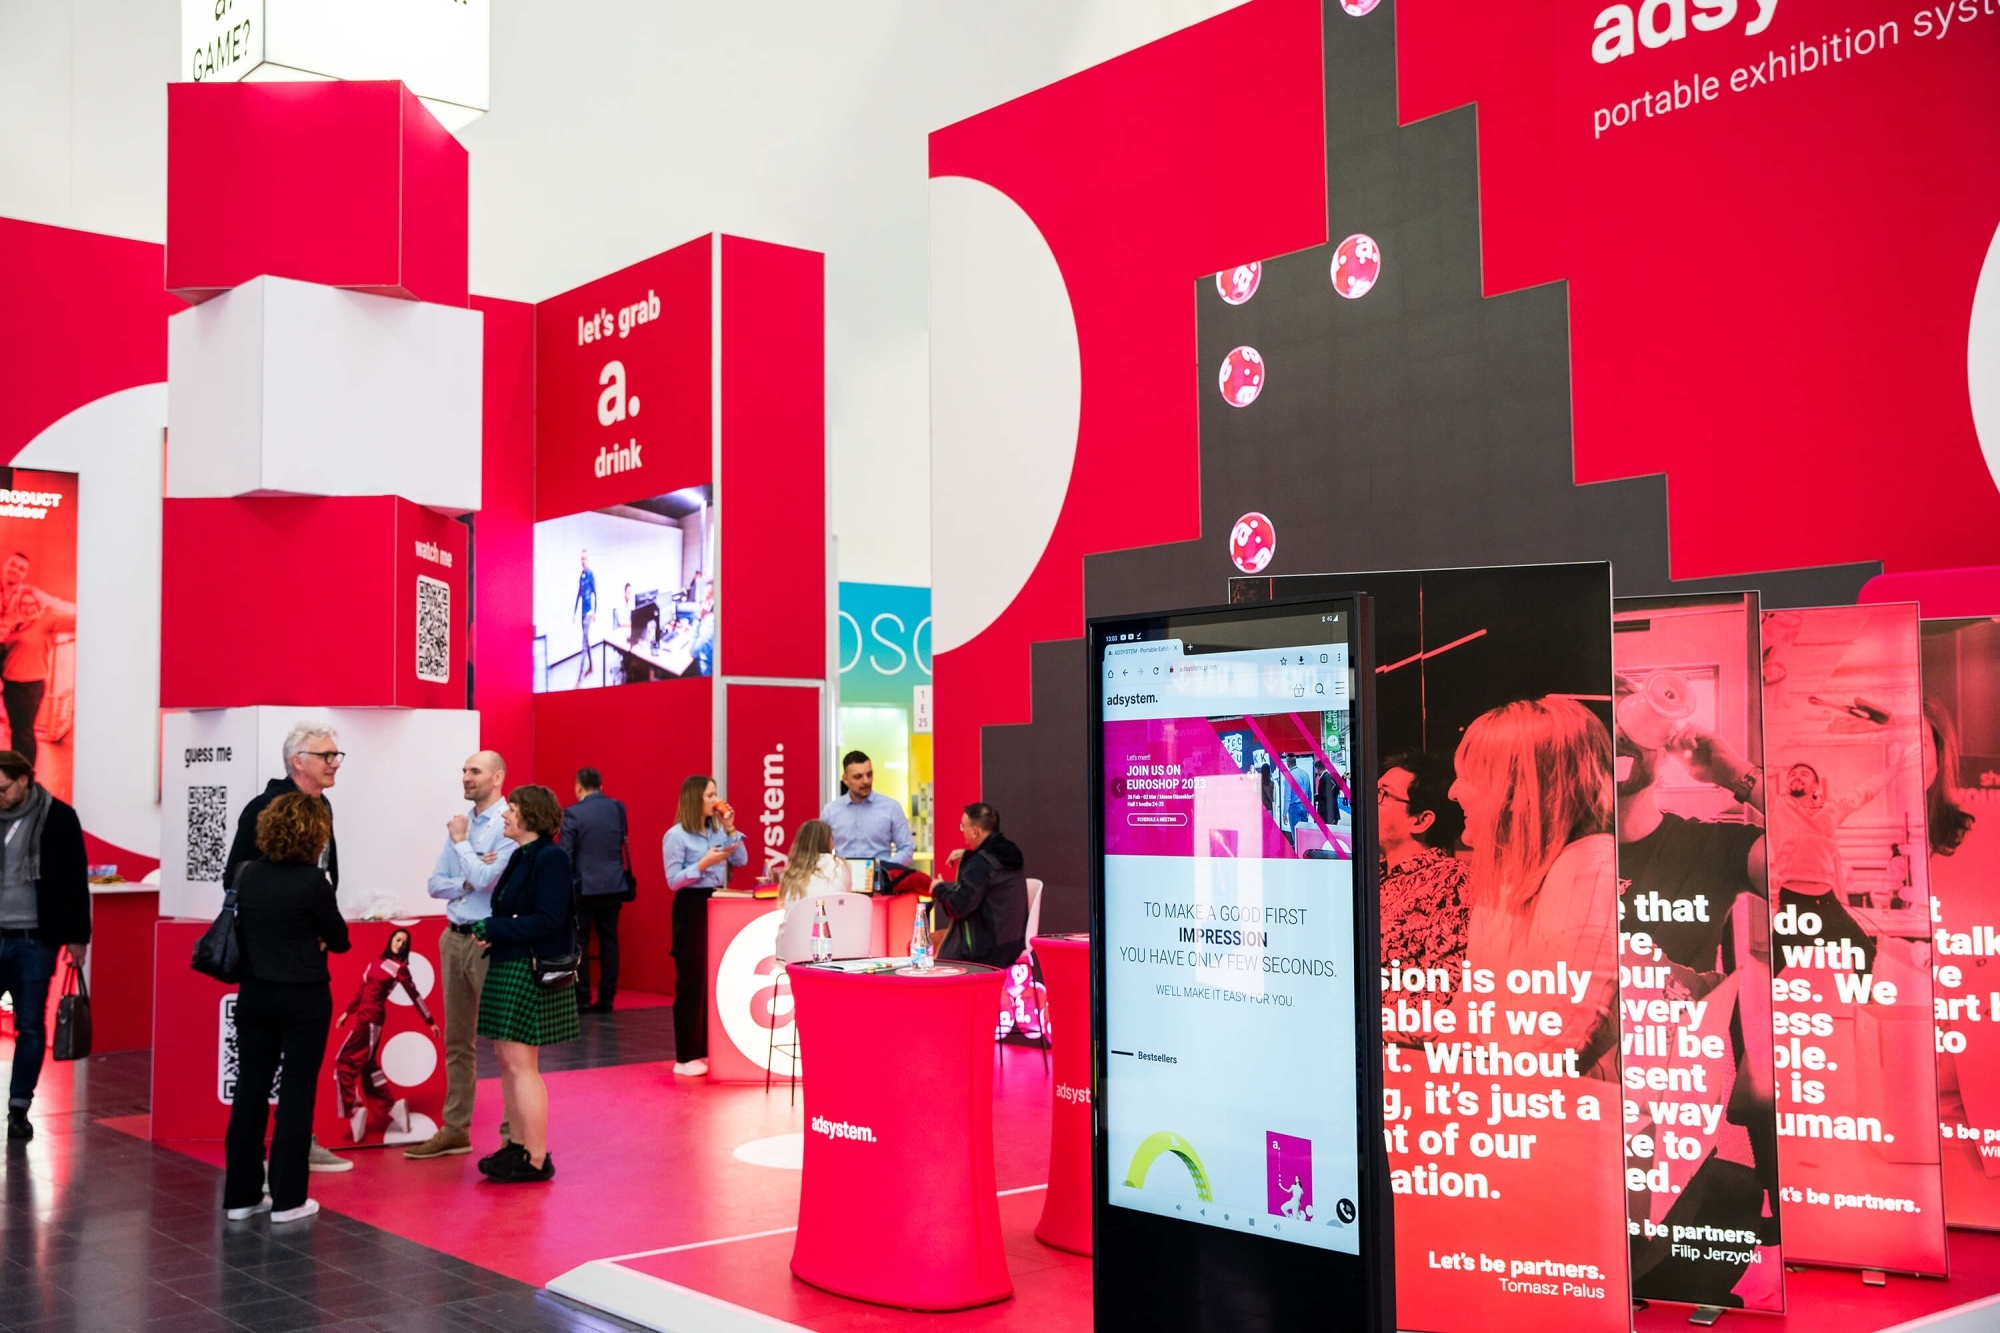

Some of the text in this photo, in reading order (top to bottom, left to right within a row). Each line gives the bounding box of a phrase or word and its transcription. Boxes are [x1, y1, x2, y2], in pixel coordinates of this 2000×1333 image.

[192, 19, 250, 82] GAME?
[1594, 0, 2000, 139] portable exhibition sys
[578, 289, 661, 346] let's grab
[597, 360, 640, 426] a.
[595, 438, 642, 478] drink
[415, 540, 452, 568] watch me
[1107, 693, 1158, 707] adsystem.
[184, 747, 232, 768] guess me
[1126, 764, 1181, 776] JOIN US ON
[1126, 778, 1206, 790] EUROSHOP 2023
[1143, 902, 1307, 925] TO MAKE A GOOD FIRST
[1634, 891, 1710, 923] that
[1773, 904, 1822, 936] do
[1179, 927, 1268, 948] IMPRESSION
[1934, 926, 2000, 956] talk
[1120, 946, 1338, 977] YOU HAVE ONLY FEW SECONDS.
[1781, 938, 1866, 970] with
[1462, 960, 1495, 993] is
[1506, 961, 1593, 1004] only
[1773, 973, 1898, 1006] es. We
[1933, 965, 1962, 988] e
[1156, 984, 1295, 1007] WE'LL MAKE IT EASY FOR YOU.
[1381, 999, 1563, 1036] able if we
[1621, 998, 1708, 1031] very
[1773, 1011, 1834, 1037] ess
[1678, 1026, 1725, 1058] be
[1935, 1026, 1967, 1054] to
[1138, 1051, 1177, 1064] Bestsellers
[1382, 1041, 1580, 1078] t. Without
[1624, 1064, 1707, 1093] sent
[1791, 1071, 1825, 1104] is
[1424, 1081, 1479, 1116] it's
[1487, 1083, 1566, 1125] just
[1576, 1095, 1601, 1121] a
[1649, 1100, 1724, 1135] way
[811, 1115, 877, 1143] adsystem.
[1418, 1122, 1459, 1156] of
[1469, 1132, 1537, 1160] our
[1777, 1112, 1894, 1144] uman.
[1957, 1123, 1980, 1140] be
[1663, 1131, 1702, 1161] to
[1390, 1162, 1501, 1199] ation.
[1627, 1161, 1681, 1194] ed.
[1780, 1186, 1921, 1213] t's be partners.
[1644, 1219, 1669, 1238] be
[1673, 1225, 1762, 1245] partners.
[1428, 1251, 1605, 1281] Let's be partners.
[1671, 1244, 1762, 1265] Filip Jerzycki
[1499, 1277, 1605, 1299] Tomasz Palus
